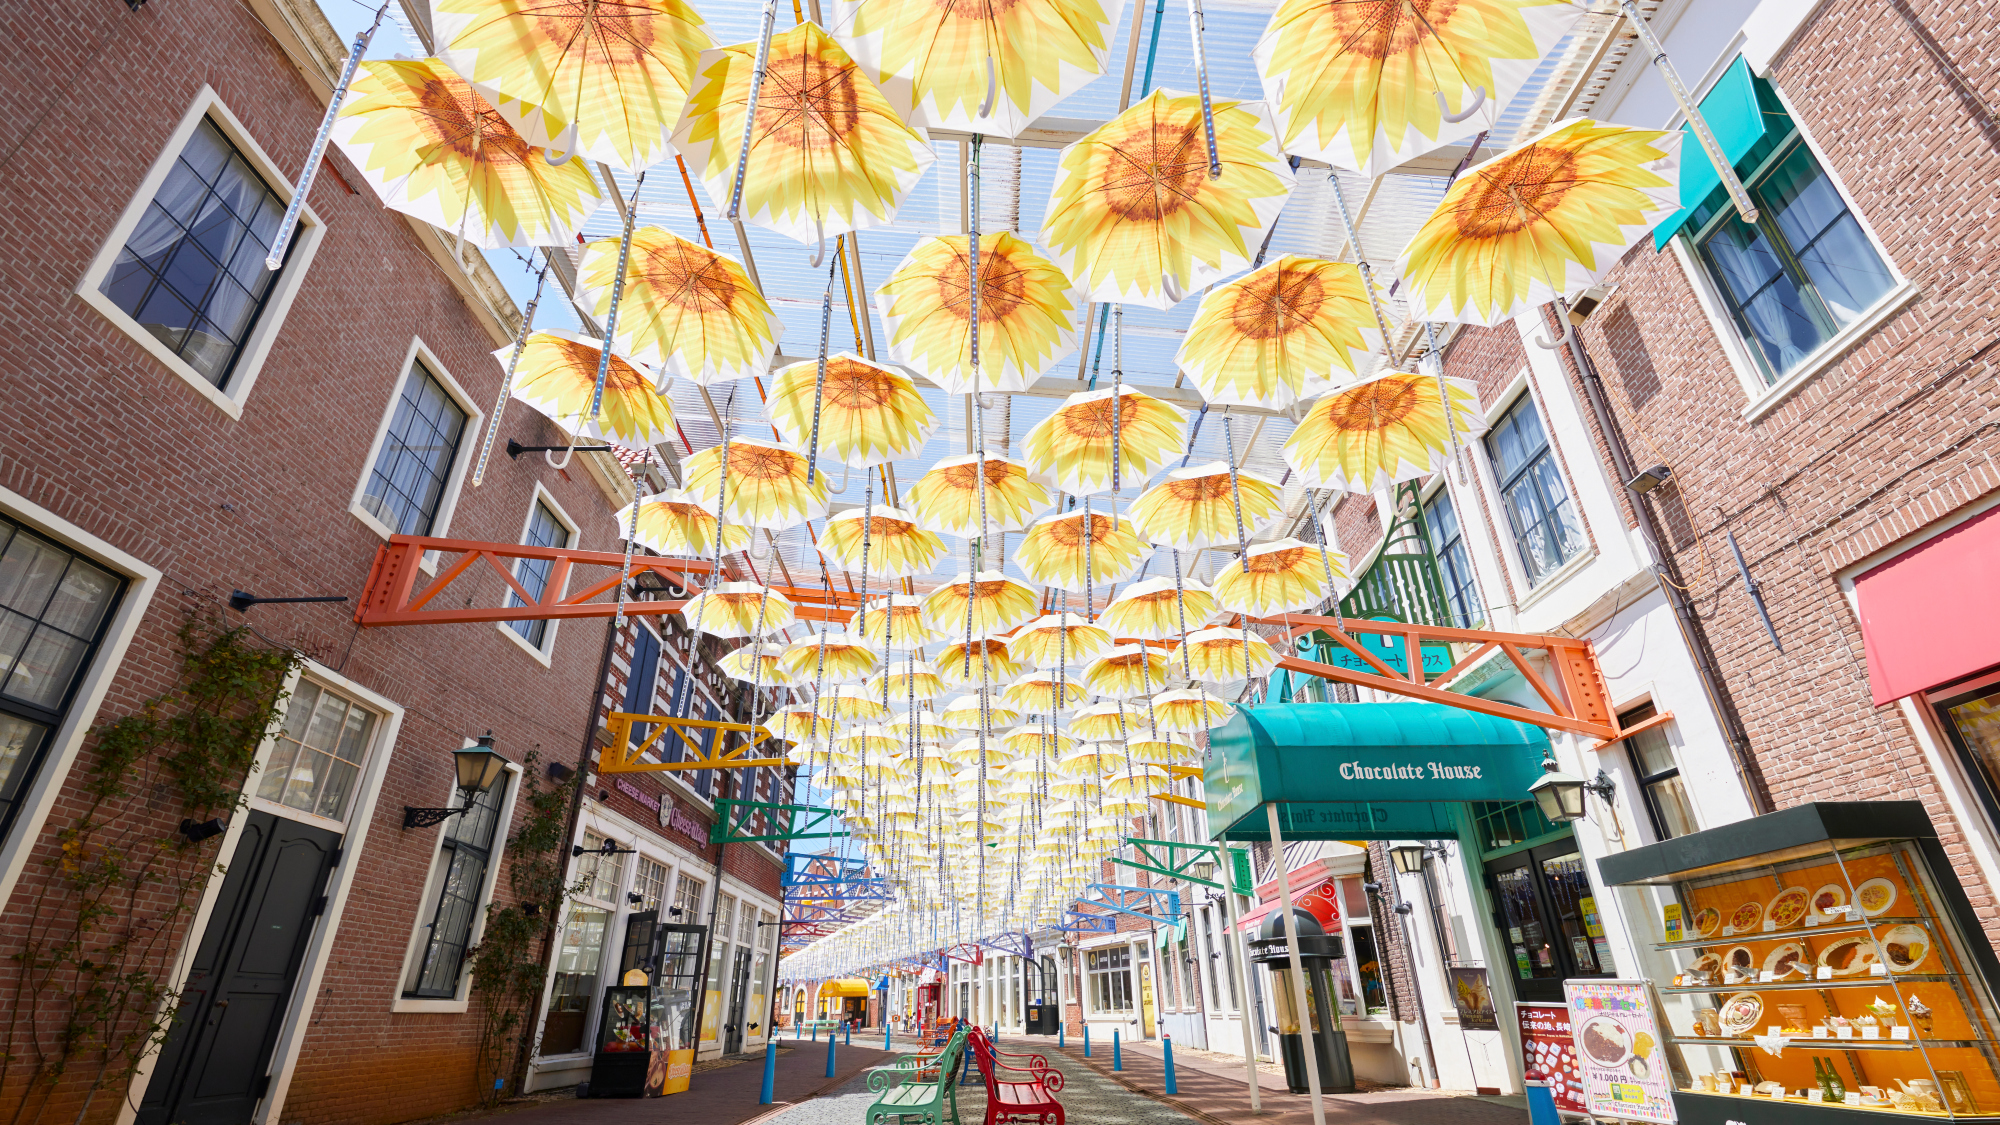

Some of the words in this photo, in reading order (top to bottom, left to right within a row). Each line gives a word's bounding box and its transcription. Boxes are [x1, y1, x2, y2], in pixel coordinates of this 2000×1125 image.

[1339, 761, 1425, 780] Chocolate
[1427, 761, 1483, 780] House
[617, 778, 640, 801] CHEESE
[639, 791, 661, 813] MARKET
[1268, 944, 1290, 954] Hous
[1521, 1010, 1557, 1020] チョコレート
